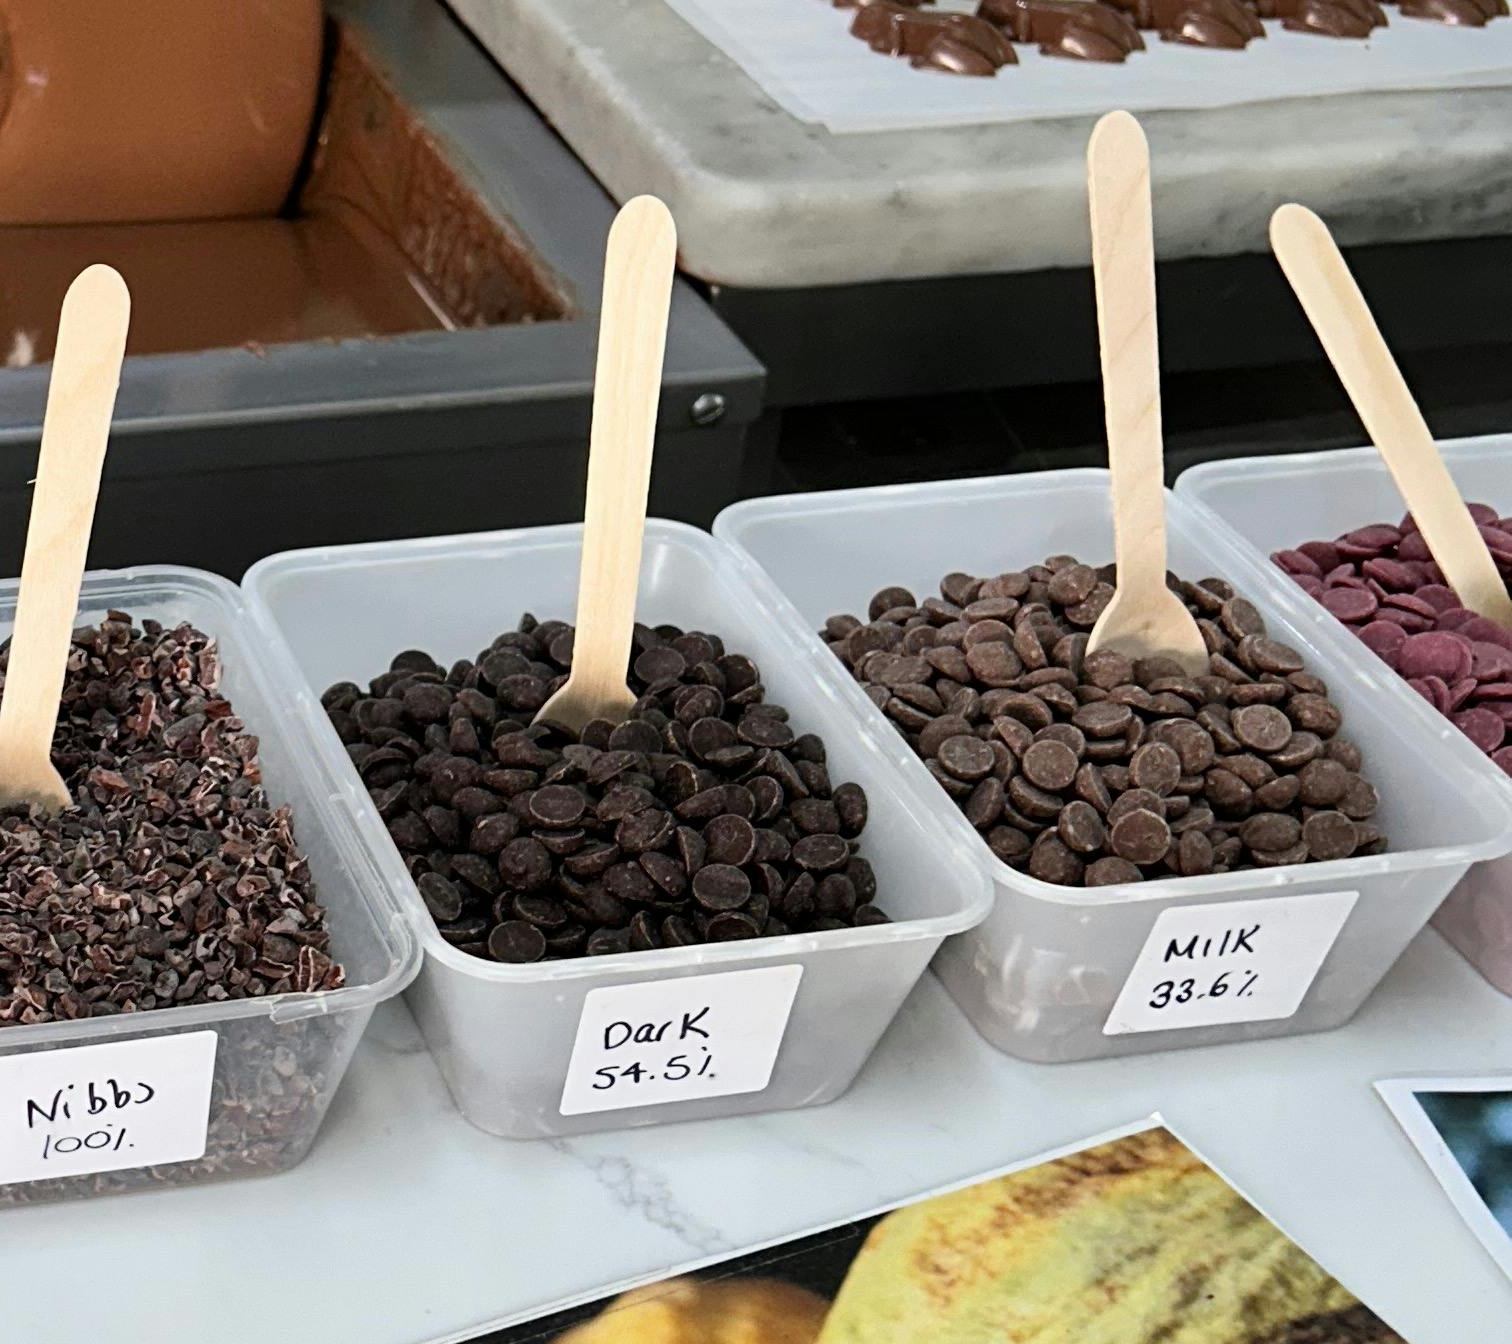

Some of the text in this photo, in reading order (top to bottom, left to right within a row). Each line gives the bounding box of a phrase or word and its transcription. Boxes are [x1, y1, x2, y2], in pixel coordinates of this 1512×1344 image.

[1149, 969, 1259, 1009] 33.6%
[26, 1078, 155, 1129] Nibbs
[42, 1123, 135, 1160] 100%
